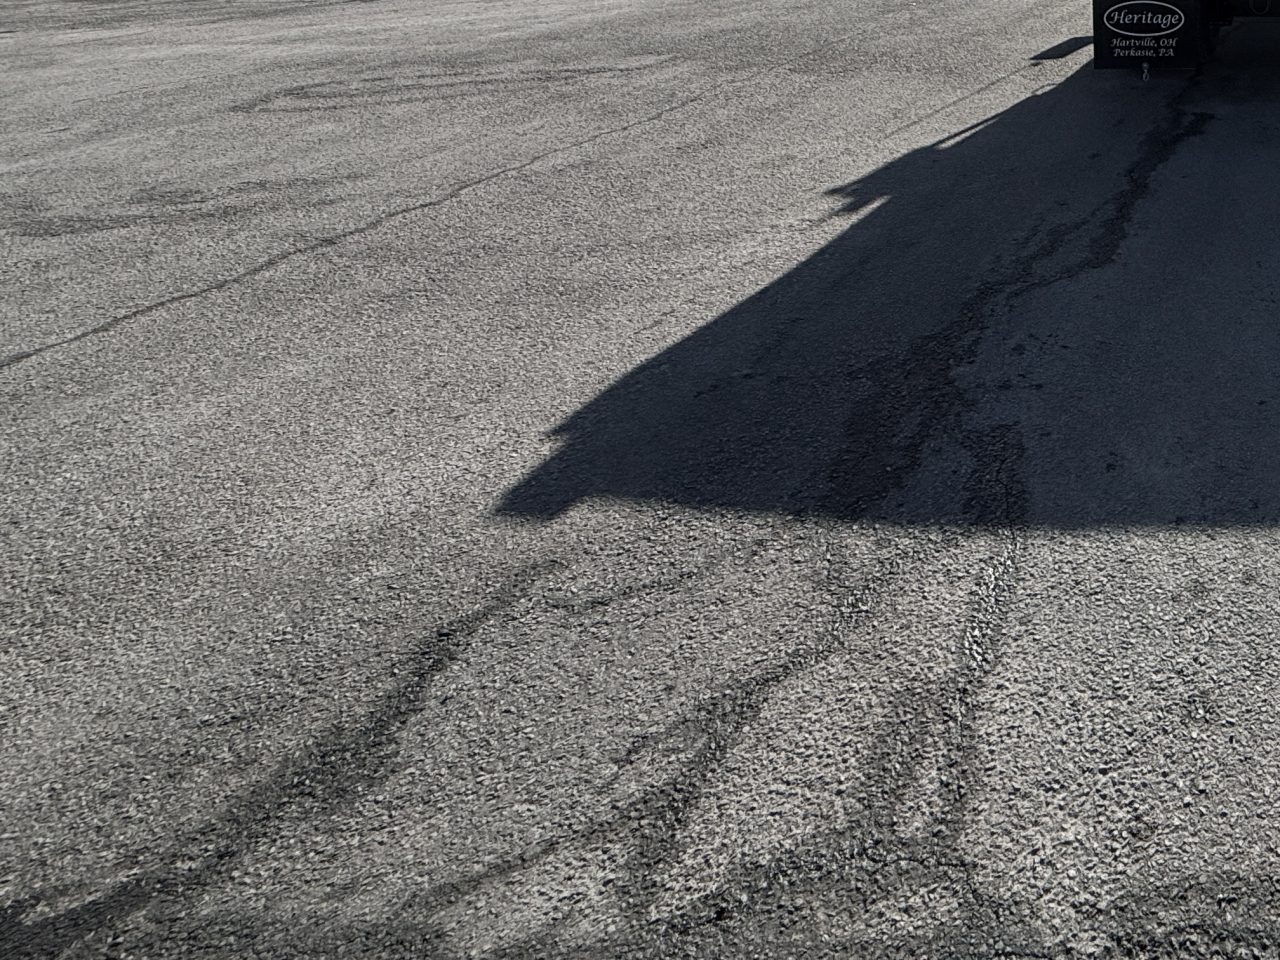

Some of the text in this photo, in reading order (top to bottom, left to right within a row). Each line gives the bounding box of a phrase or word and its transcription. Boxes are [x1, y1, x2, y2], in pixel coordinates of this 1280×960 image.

[1109, 9, 1179, 29] Heritage
[1110, 37, 1178, 47] Hartville, OH
[1158, 48, 1175, 57] PA
